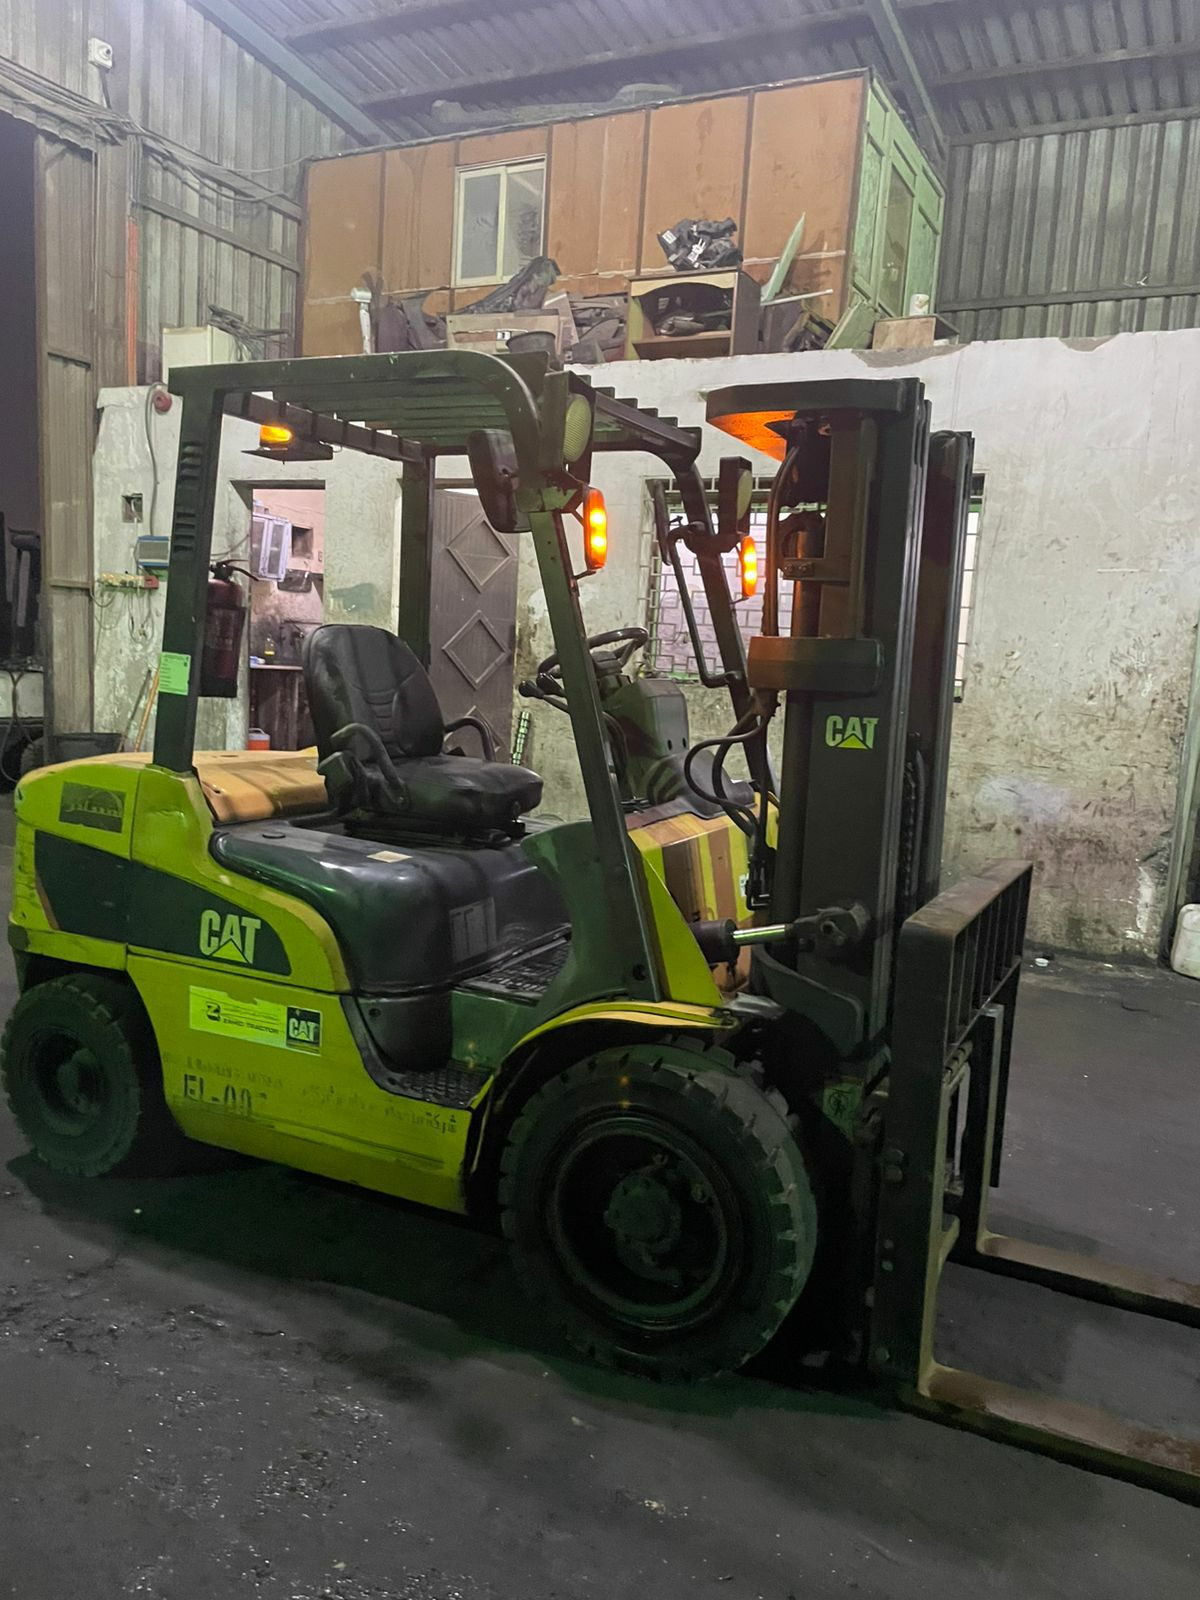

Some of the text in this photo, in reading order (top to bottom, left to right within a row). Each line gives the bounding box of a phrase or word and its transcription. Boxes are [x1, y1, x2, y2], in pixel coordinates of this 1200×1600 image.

[825, 715, 879, 750] CAT
[200, 909, 261, 964] CAT
[288, 1017, 320, 1042] CAT
